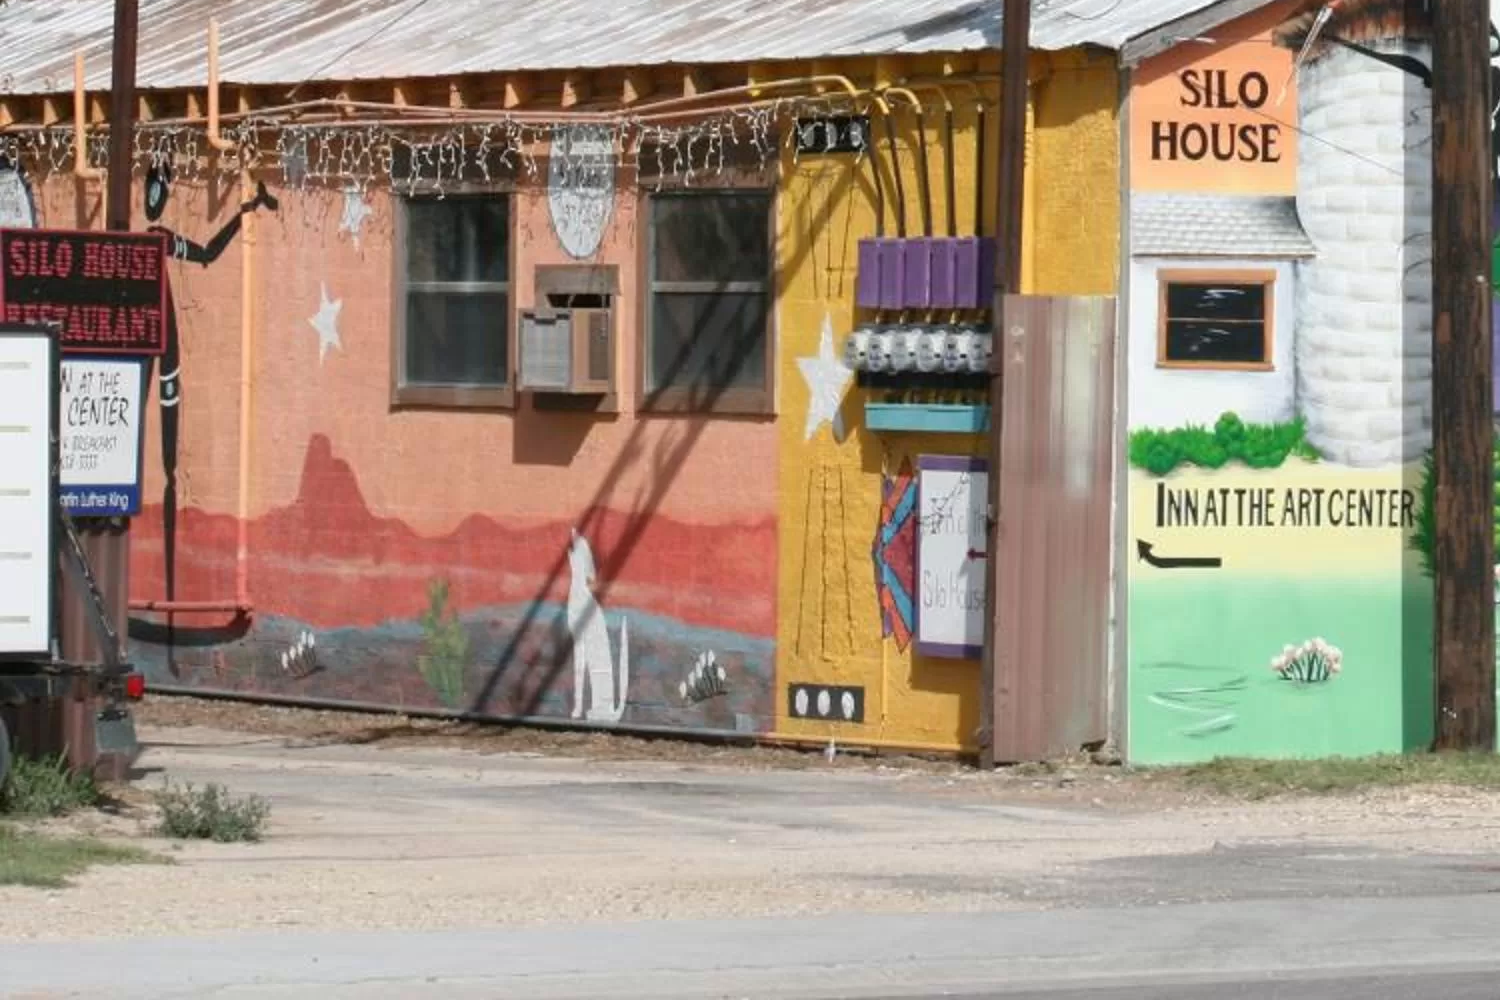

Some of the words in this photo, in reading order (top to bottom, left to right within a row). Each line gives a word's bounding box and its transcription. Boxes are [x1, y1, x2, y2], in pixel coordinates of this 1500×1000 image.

[1180, 69, 1269, 110] SILO
[1151, 121, 1281, 163] HOUSE
[10, 240, 73, 278] SILO
[83, 242, 158, 280] HOUSE
[79, 372, 93, 394] AT
[99, 372, 121, 395] THE
[67, 396, 129, 427] CENTER
[1156, 482, 1199, 528] INN
[1203, 488, 1230, 528] AT
[1234, 488, 1275, 527] THE
[1280, 488, 1325, 528] ART
[1327, 489, 1416, 529] CENTER
